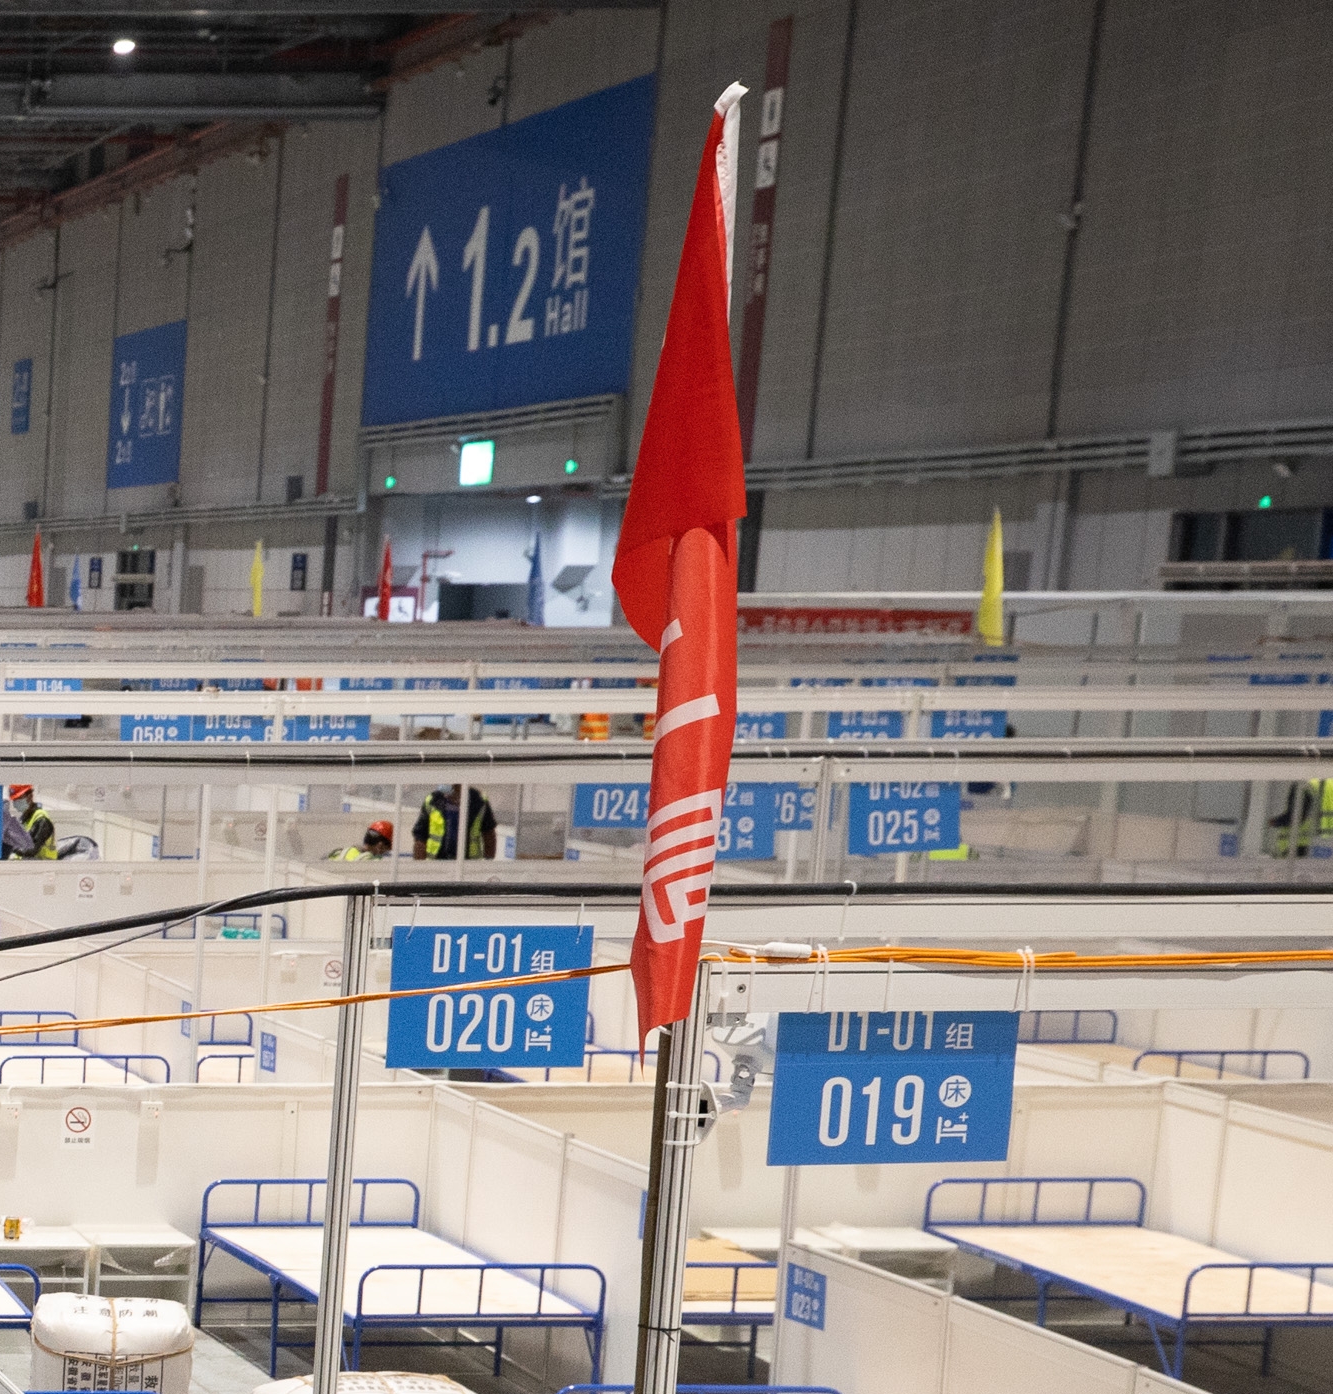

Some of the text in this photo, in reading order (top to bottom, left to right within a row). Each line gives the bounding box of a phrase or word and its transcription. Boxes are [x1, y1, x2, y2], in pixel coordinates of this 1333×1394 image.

[462, 205, 540, 352] 1.2
[544, 288, 589, 338] Hall
[592, 789, 638, 822] 024
[867, 809, 919, 846] 025
[433, 933, 555, 974] D1-01 组
[426, 993, 516, 1053] 020
[827, 1011, 974, 1052] D1-01 组
[818, 1075, 925, 1147] 019
